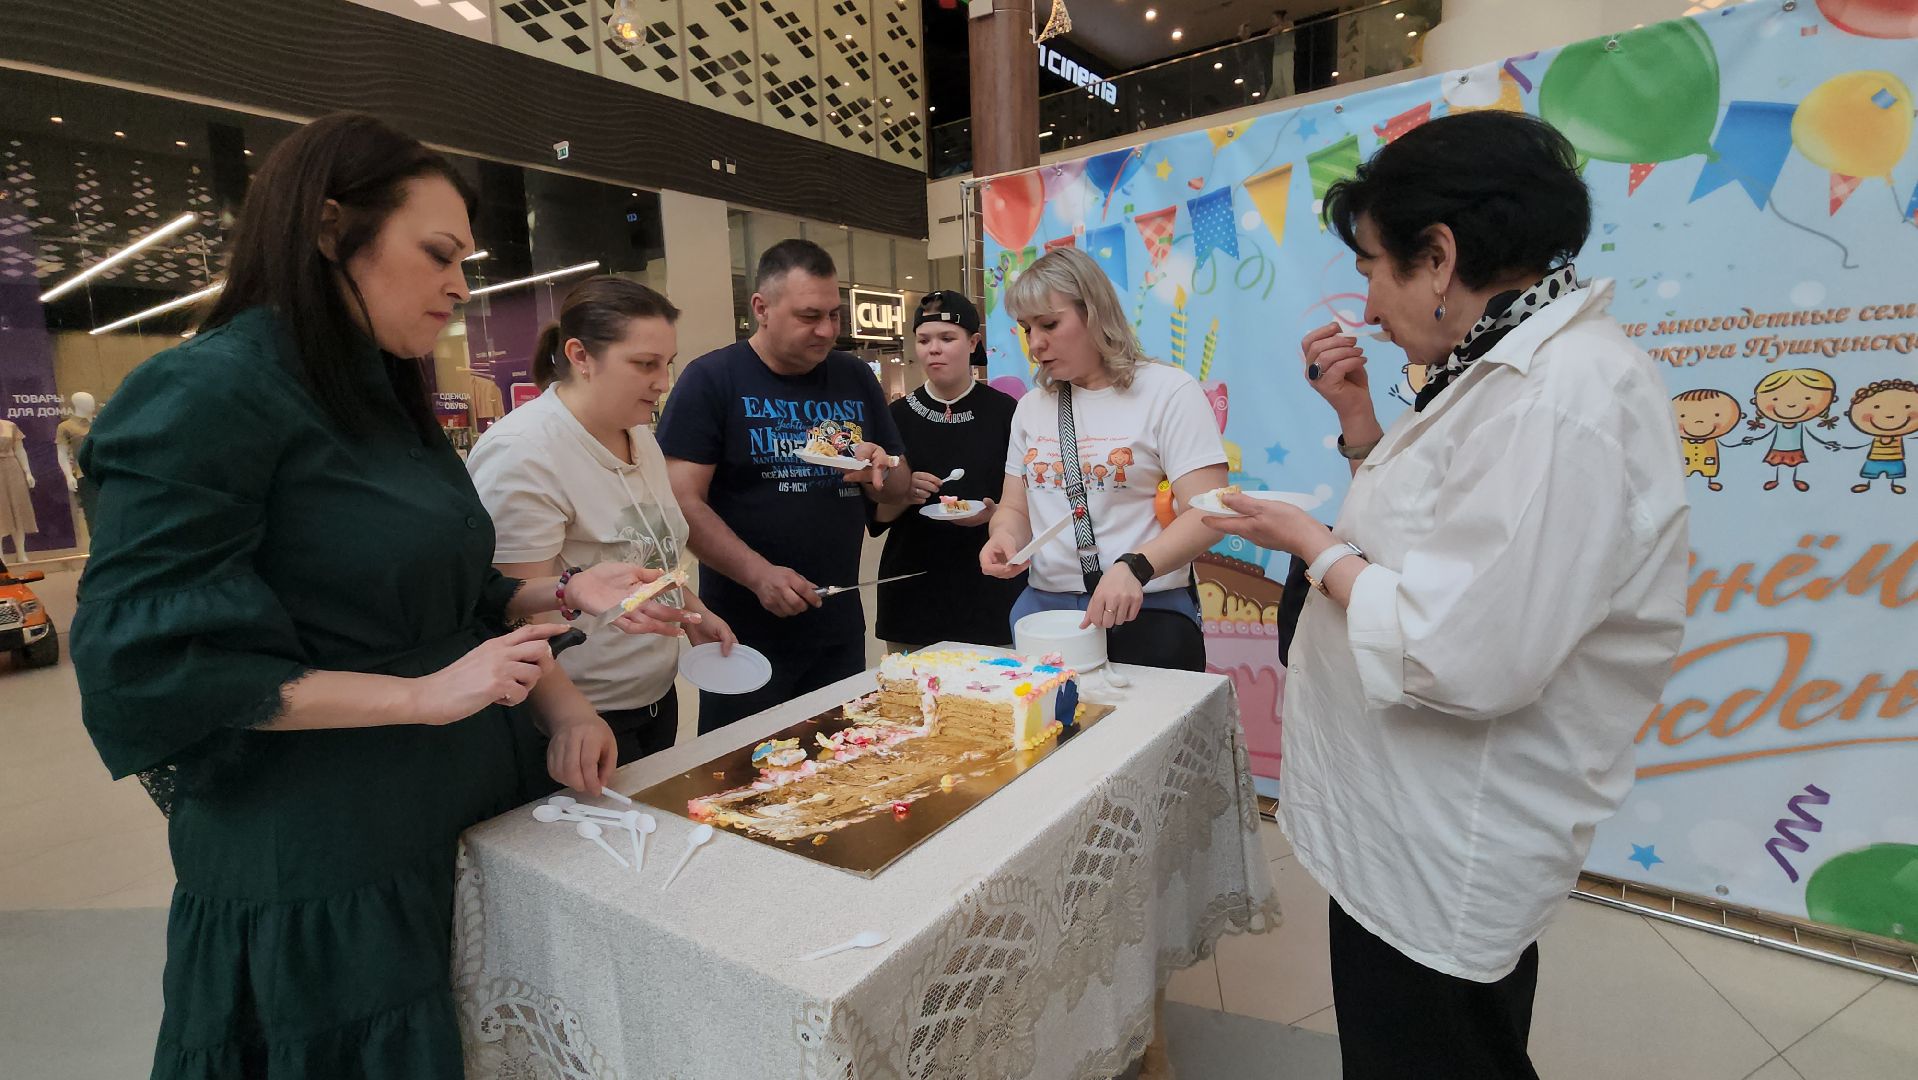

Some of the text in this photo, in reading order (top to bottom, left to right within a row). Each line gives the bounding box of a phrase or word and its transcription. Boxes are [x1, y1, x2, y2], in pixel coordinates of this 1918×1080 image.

[1048, 49, 1117, 105] cinema
[1653, 306, 1851, 335] многодетные
[7, 406, 74, 418] ДЛЯ ДОМА
[12, 394, 65, 404] ТОВАРЫ
[741, 396, 865, 422] EAST COAST
